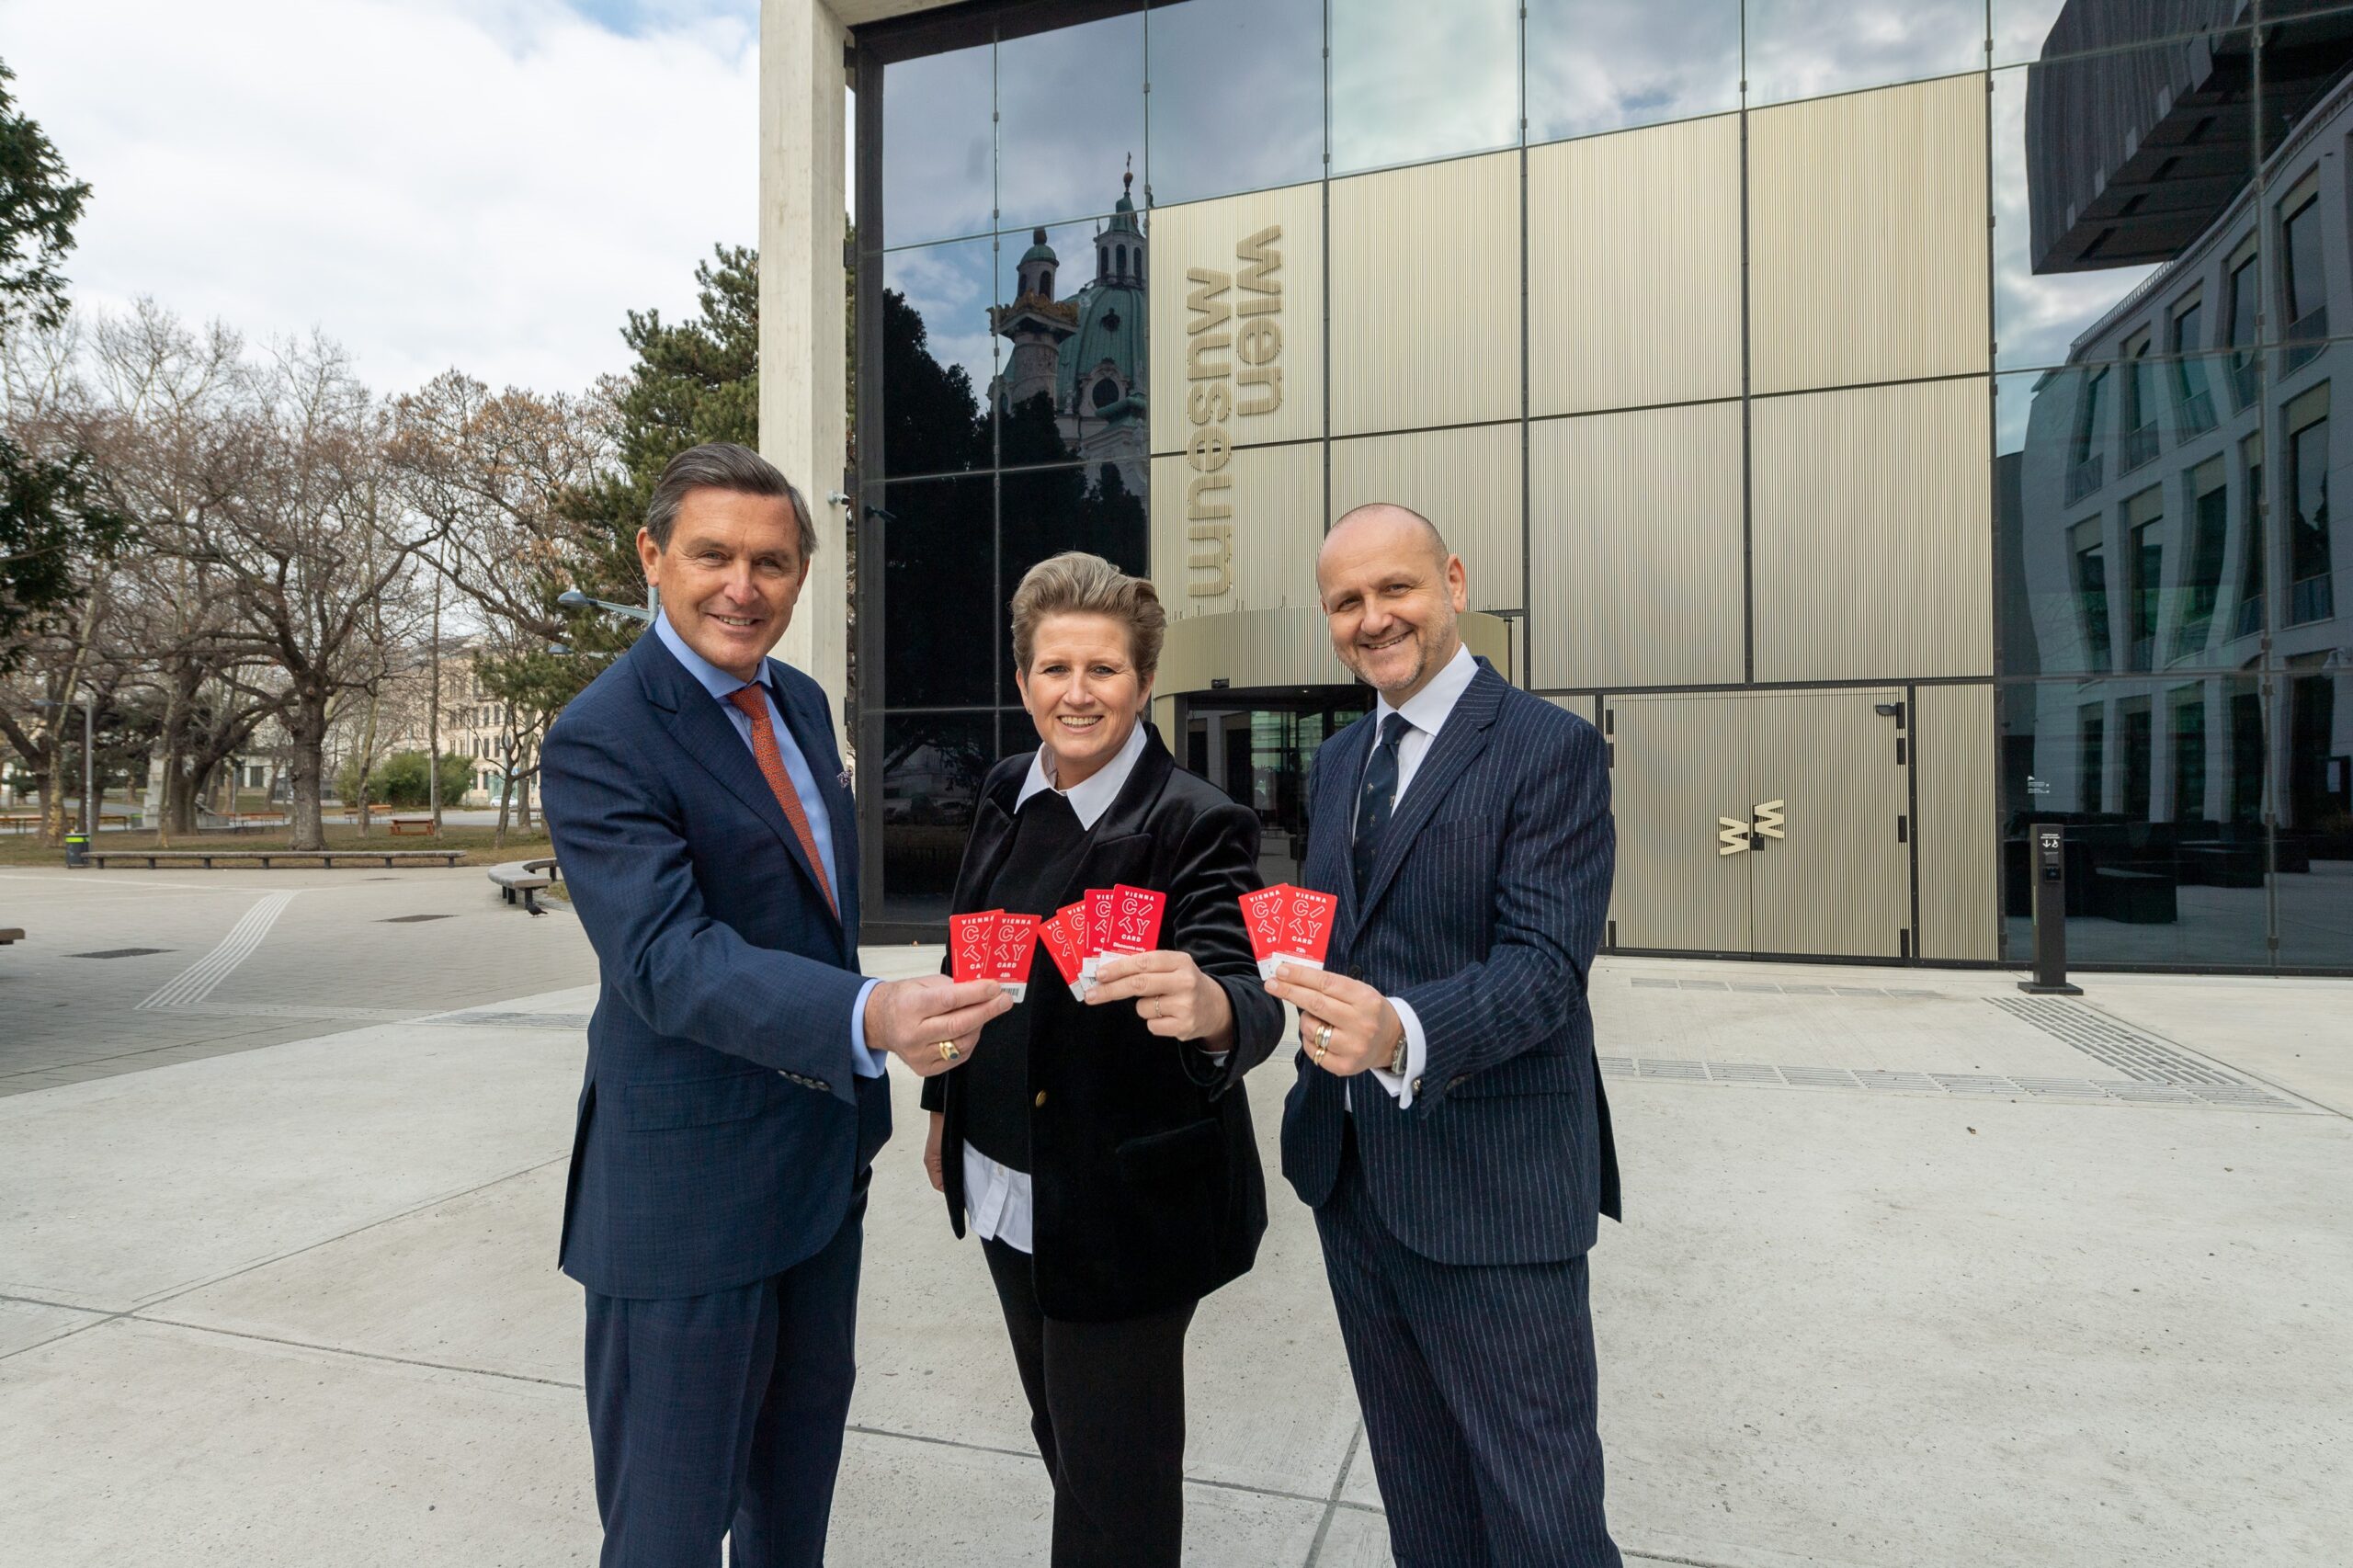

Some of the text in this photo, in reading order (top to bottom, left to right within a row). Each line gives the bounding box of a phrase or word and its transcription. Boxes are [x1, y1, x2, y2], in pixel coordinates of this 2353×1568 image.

[1125, 891, 1155, 902] VIENNA
[1249, 890, 1280, 903] VIENNA
[1295, 892, 1327, 903] VIENNA
[1047, 920, 1061, 930] VIE
[1121, 934, 1142, 943] CARD
[1291, 936, 1313, 946] CARD
[970, 962, 984, 971] CA
